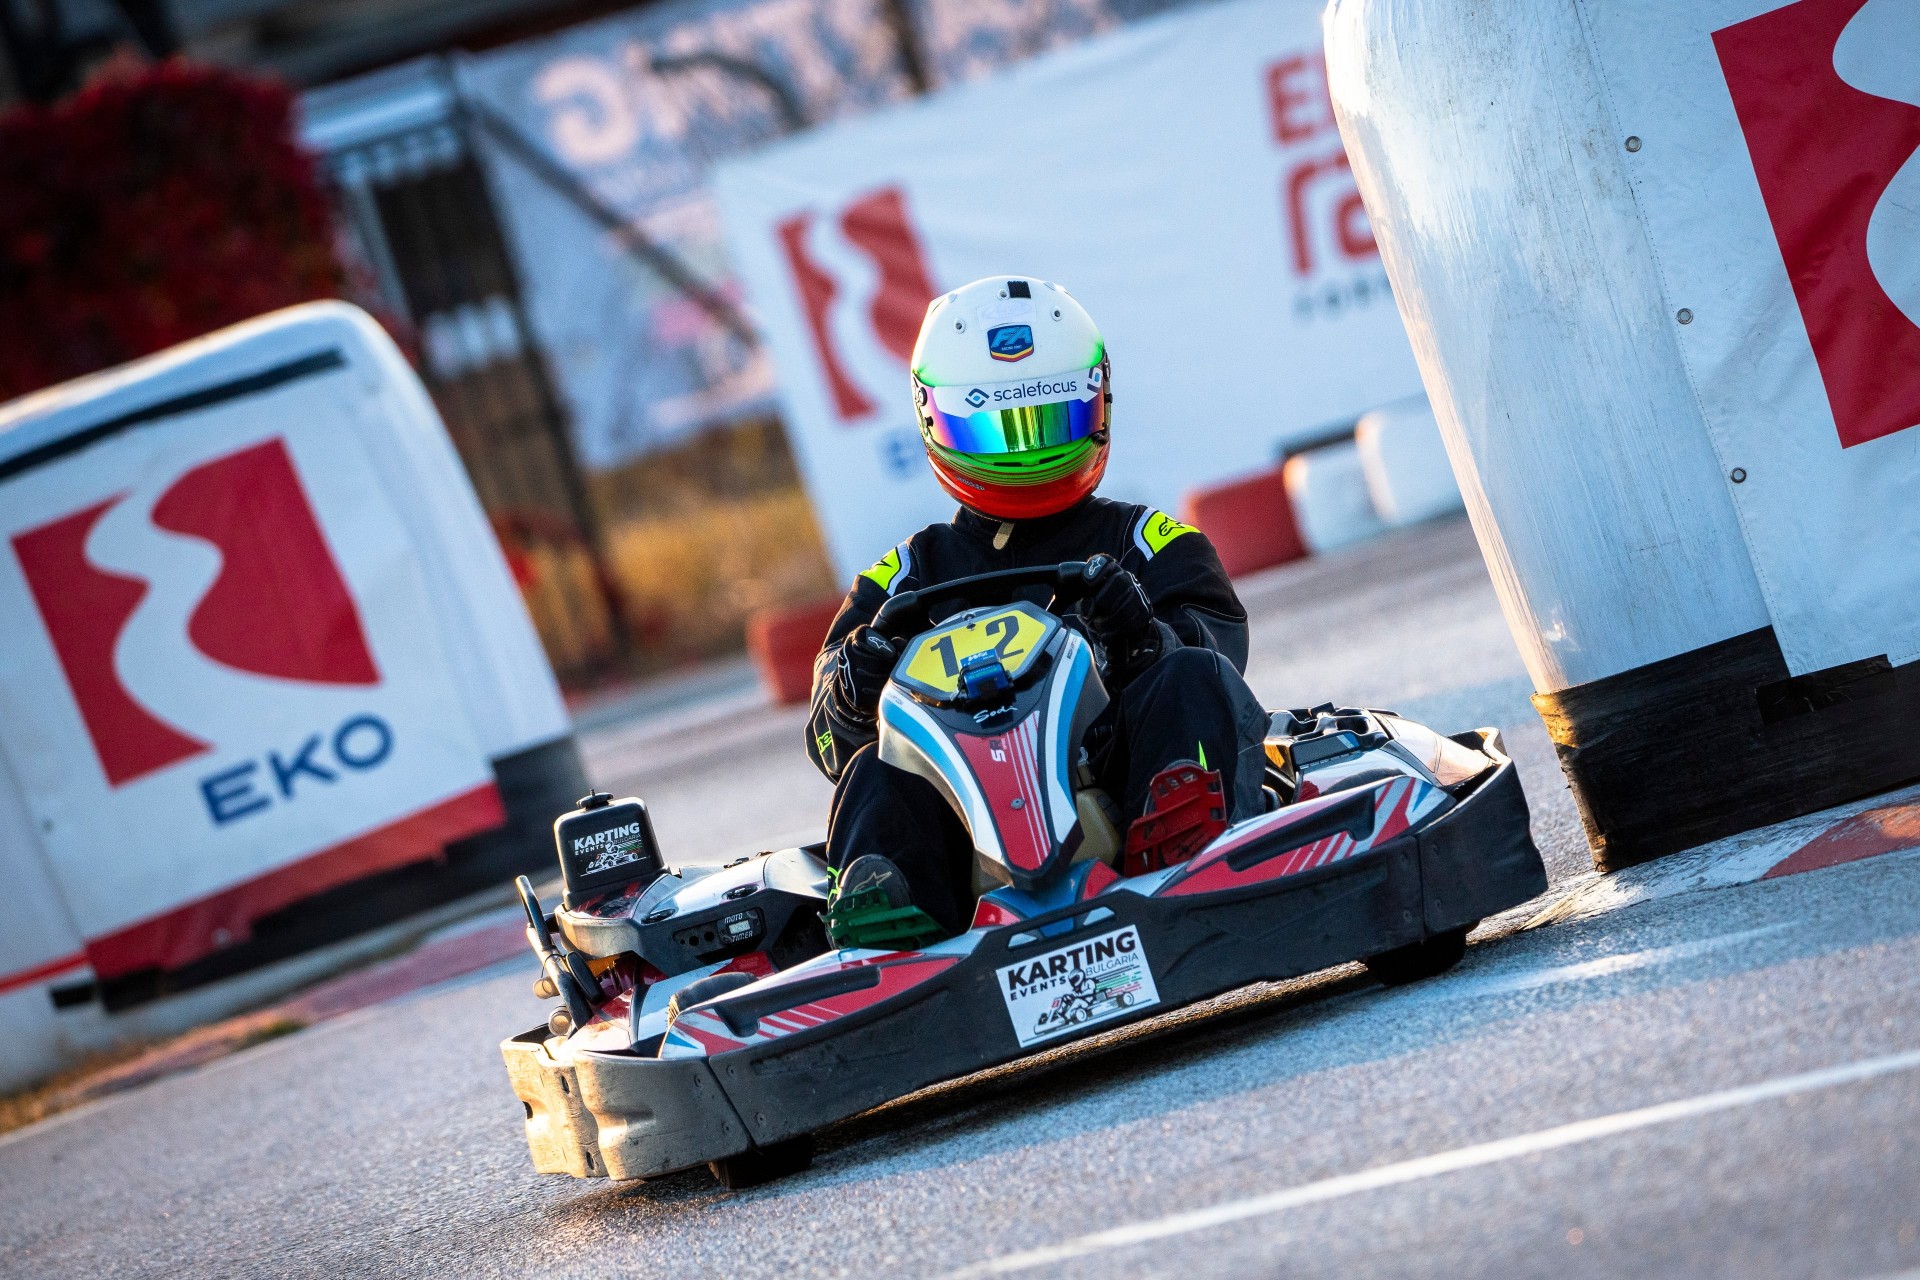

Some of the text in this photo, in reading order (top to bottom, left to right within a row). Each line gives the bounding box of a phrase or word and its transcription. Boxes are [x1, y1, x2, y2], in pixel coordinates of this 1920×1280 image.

[993, 380, 1077, 402] scalefocus
[930, 615, 1024, 678] 12
[201, 713, 394, 827] EKO
[574, 822, 640, 851] KARTING
[575, 833, 641, 856] EVENTS BULGARIA
[1007, 931, 1136, 991] KARTING
[1010, 952, 1139, 1001] EVENTS BULGARIA
